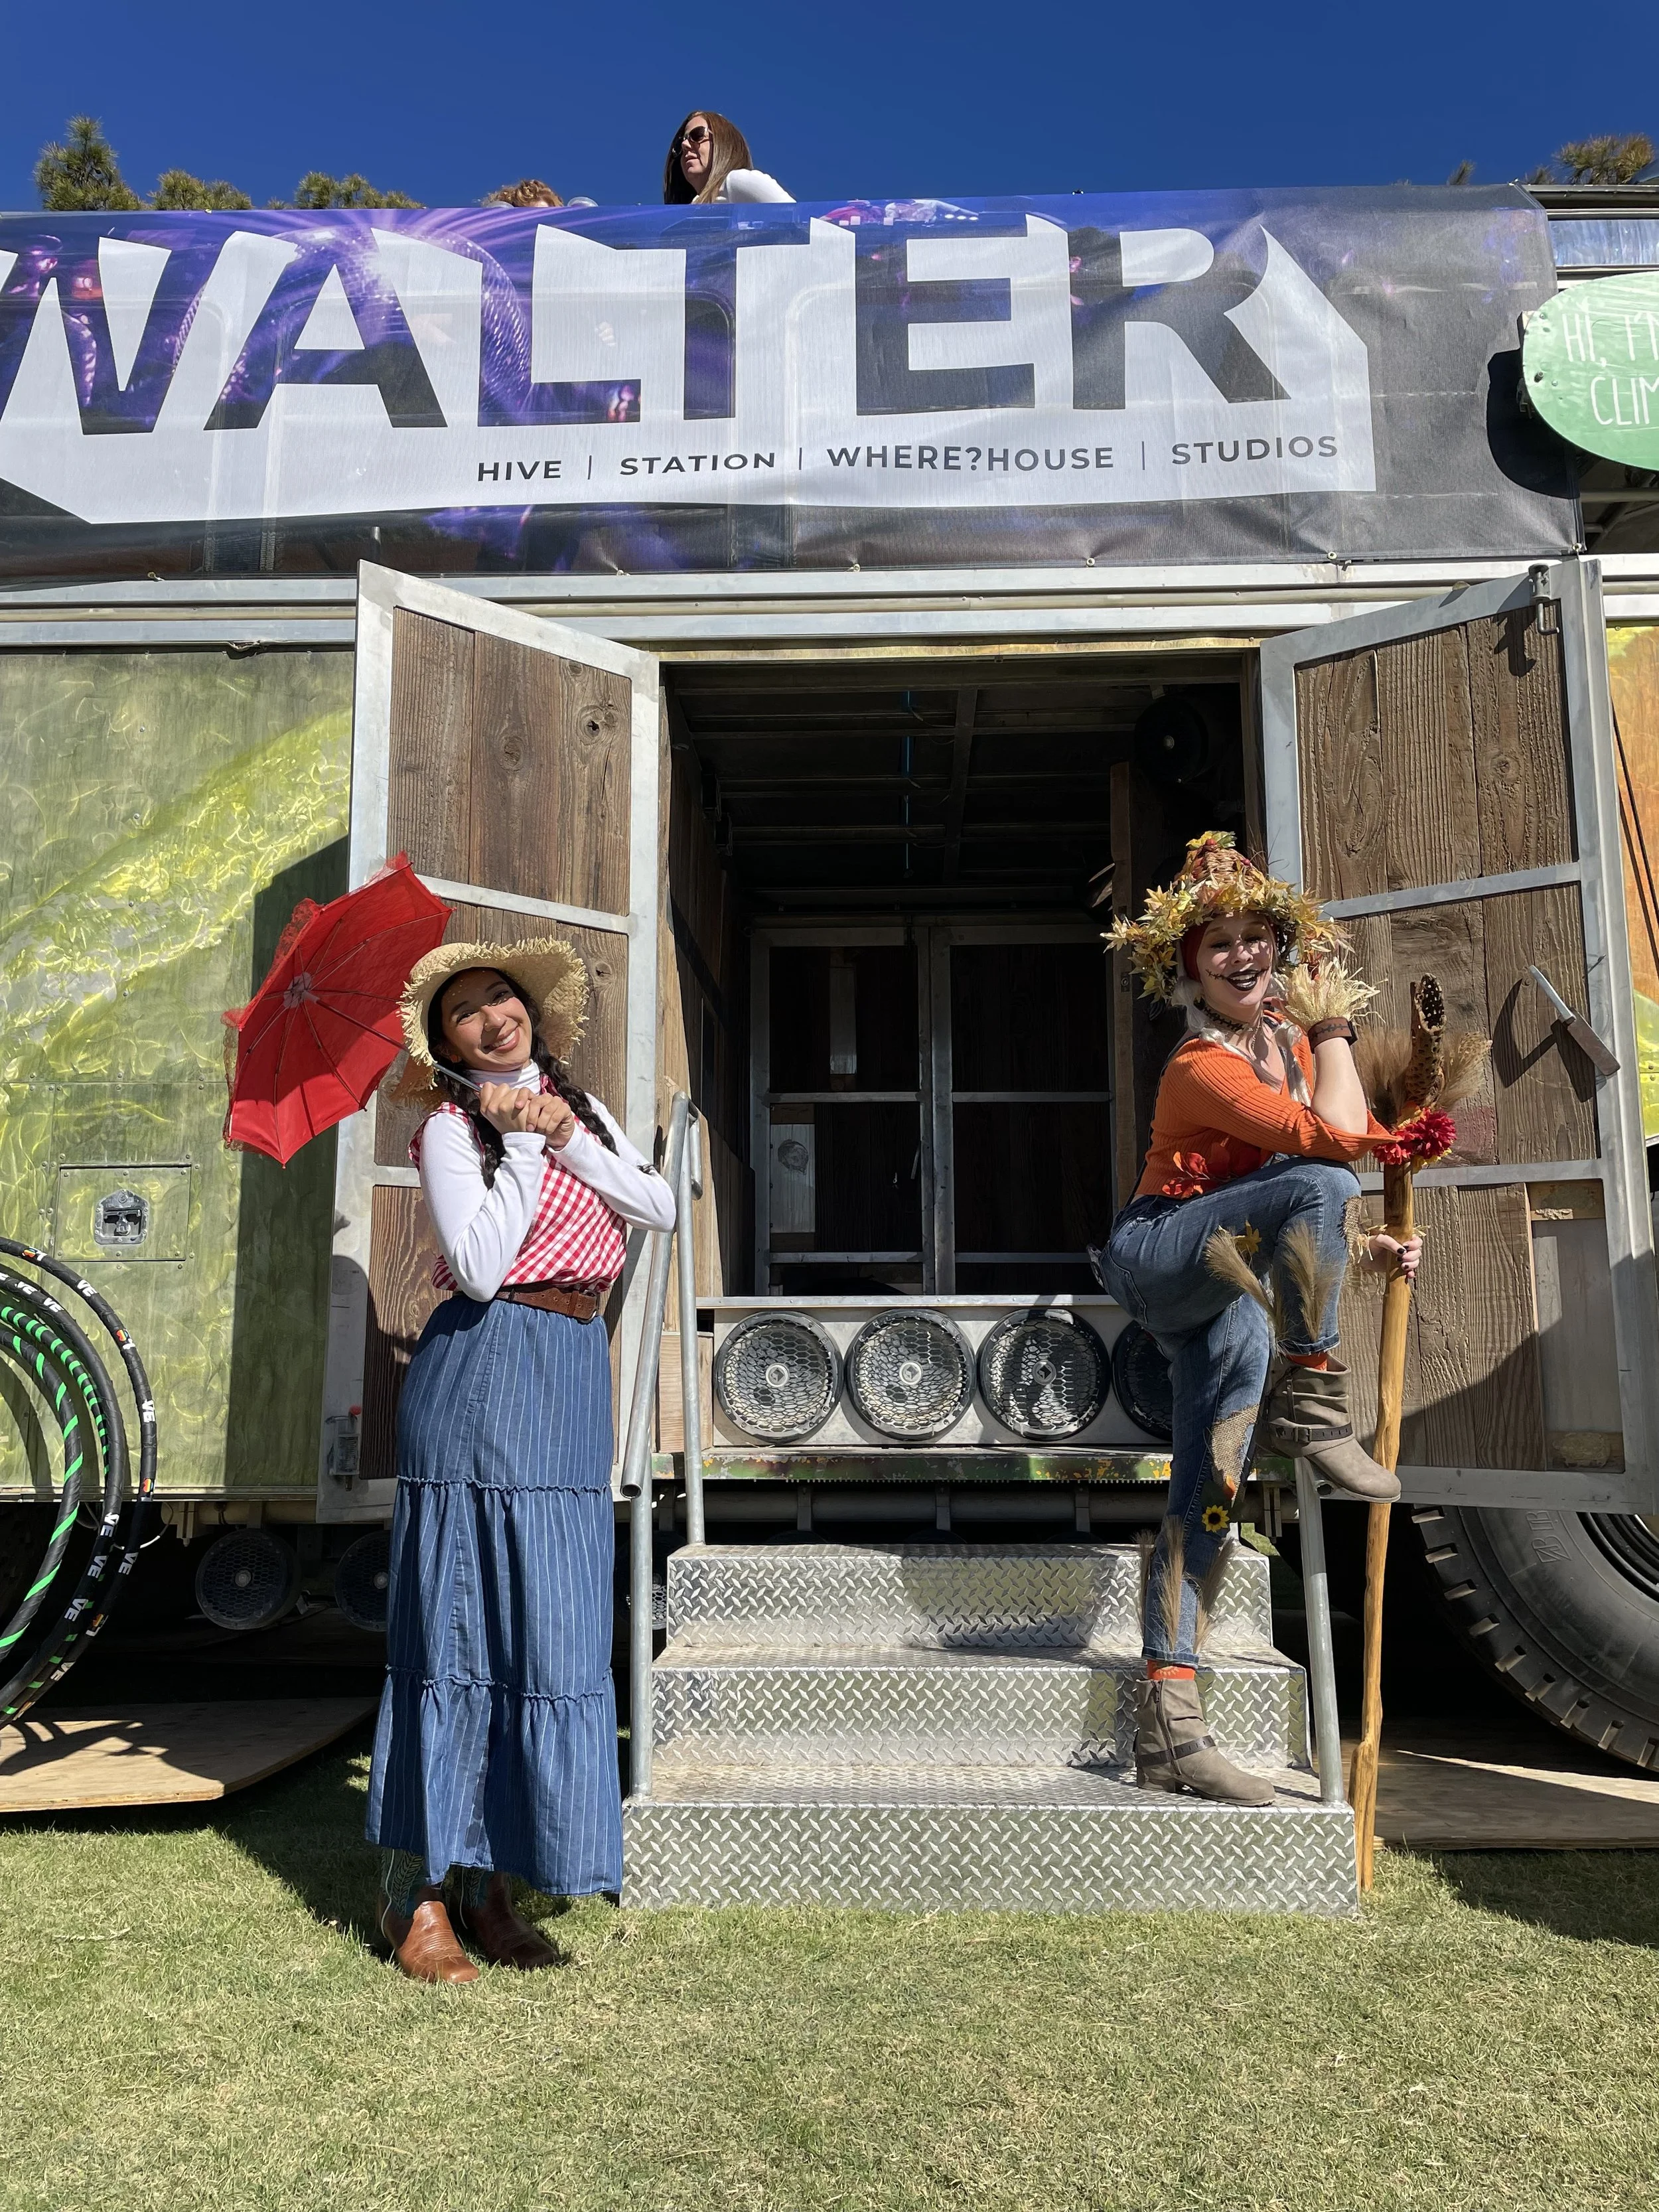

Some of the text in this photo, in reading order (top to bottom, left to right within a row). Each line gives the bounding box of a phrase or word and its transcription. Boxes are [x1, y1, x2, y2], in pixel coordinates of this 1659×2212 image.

[0, 218, 1291, 435] WALTER
[478, 436, 1335, 482] HIVE STATION WHERE?HOUSE STUDIOS
